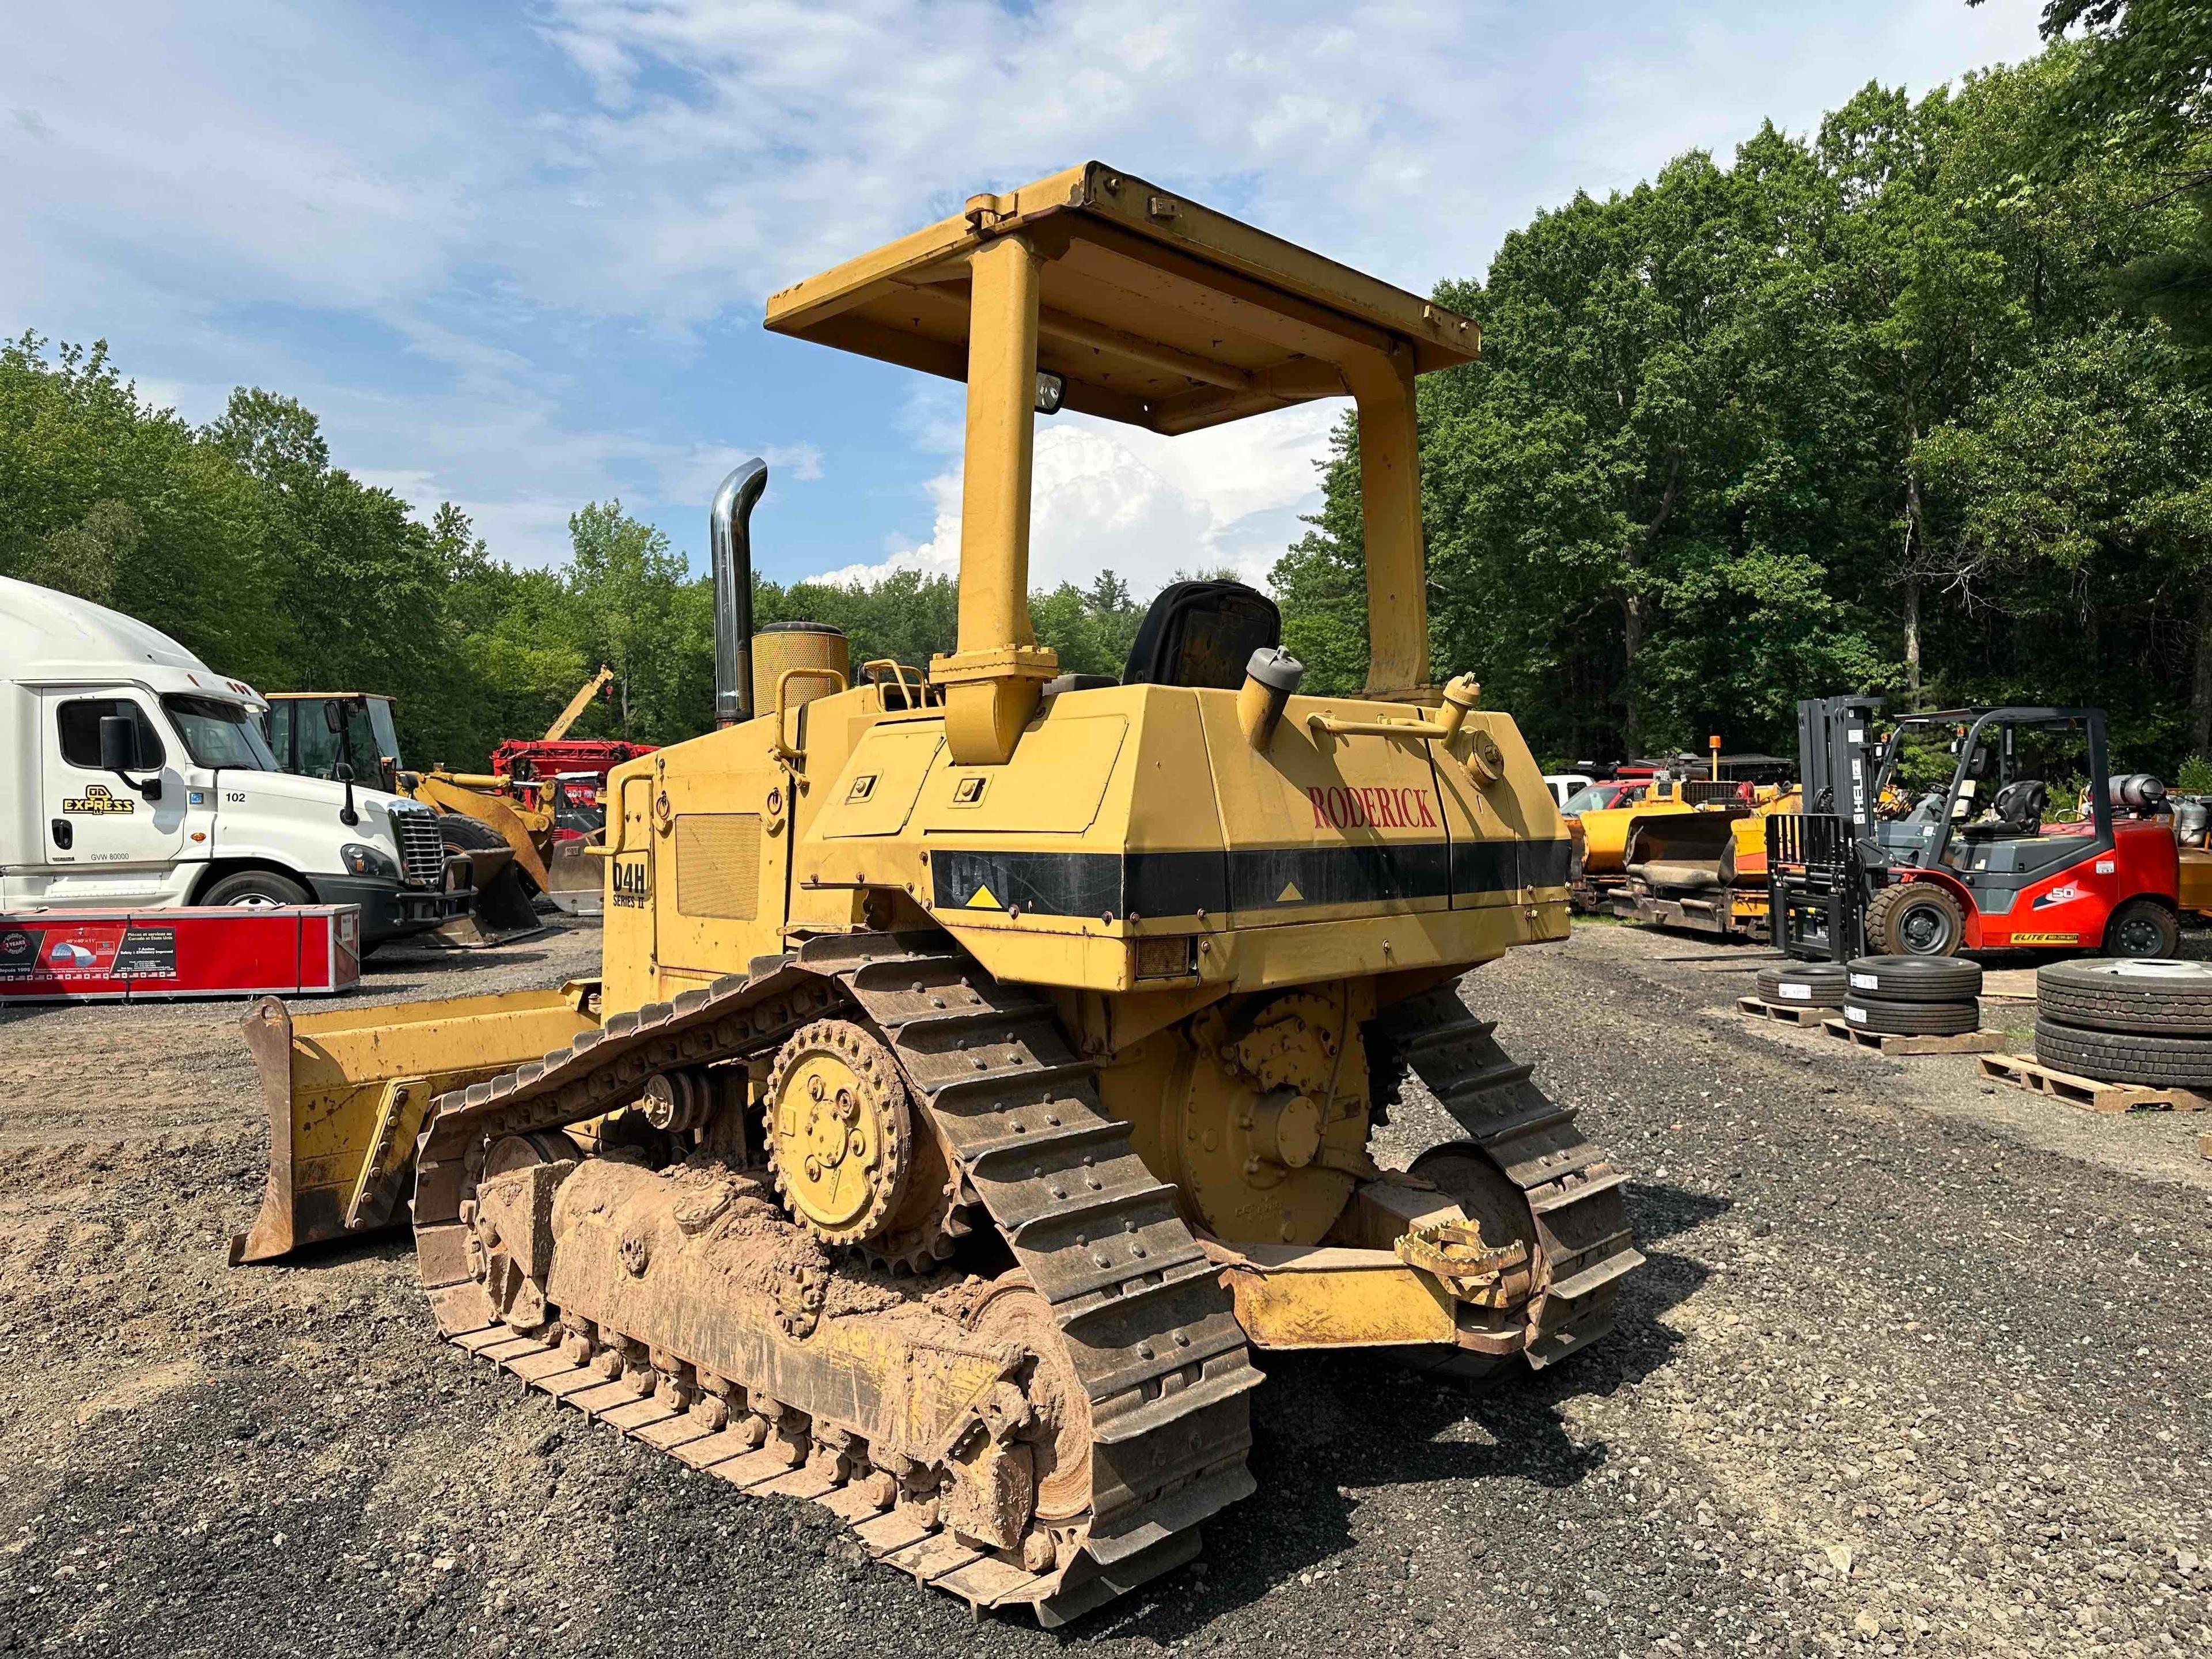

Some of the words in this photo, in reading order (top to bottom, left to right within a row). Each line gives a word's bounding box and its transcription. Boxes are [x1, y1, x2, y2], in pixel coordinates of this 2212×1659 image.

[225, 793, 245, 802] 102
[63, 799, 135, 810] EXPRESS
[1306, 786, 1437, 829] RODERICK
[612, 862, 645, 894] D4H
[2052, 887, 2074, 899] 50
[613, 894, 635, 908] SERIES
[638, 896, 645, 909] II
